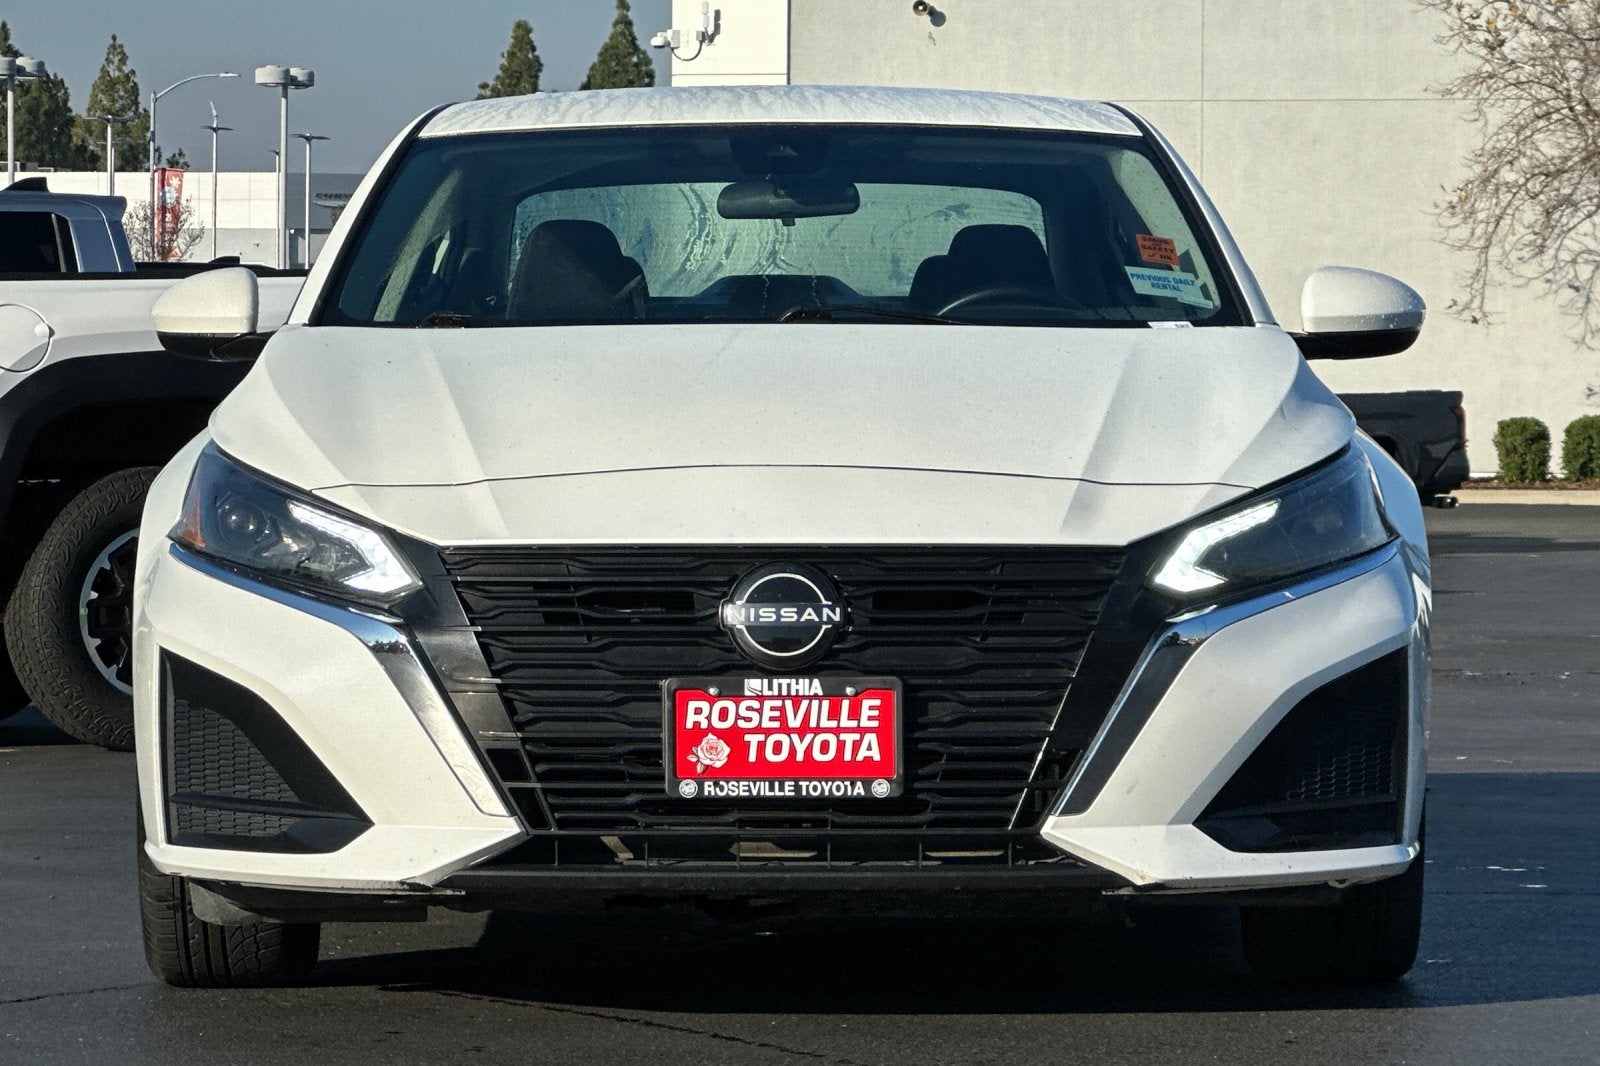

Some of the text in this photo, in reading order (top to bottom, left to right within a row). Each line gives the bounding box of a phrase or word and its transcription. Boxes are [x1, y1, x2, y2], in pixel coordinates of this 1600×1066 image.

[1130, 272, 1195, 287] PREVIOUS DAILY
[1151, 282, 1183, 292] RENTAL
[727, 607, 841, 622] NISSAN
[761, 678, 823, 696] LITHIA
[685, 698, 882, 729] ROSEVILLE
[744, 732, 882, 763] TOYOTA
[703, 781, 796, 796] ROSEVILLE
[799, 781, 866, 796] TOYOTA
